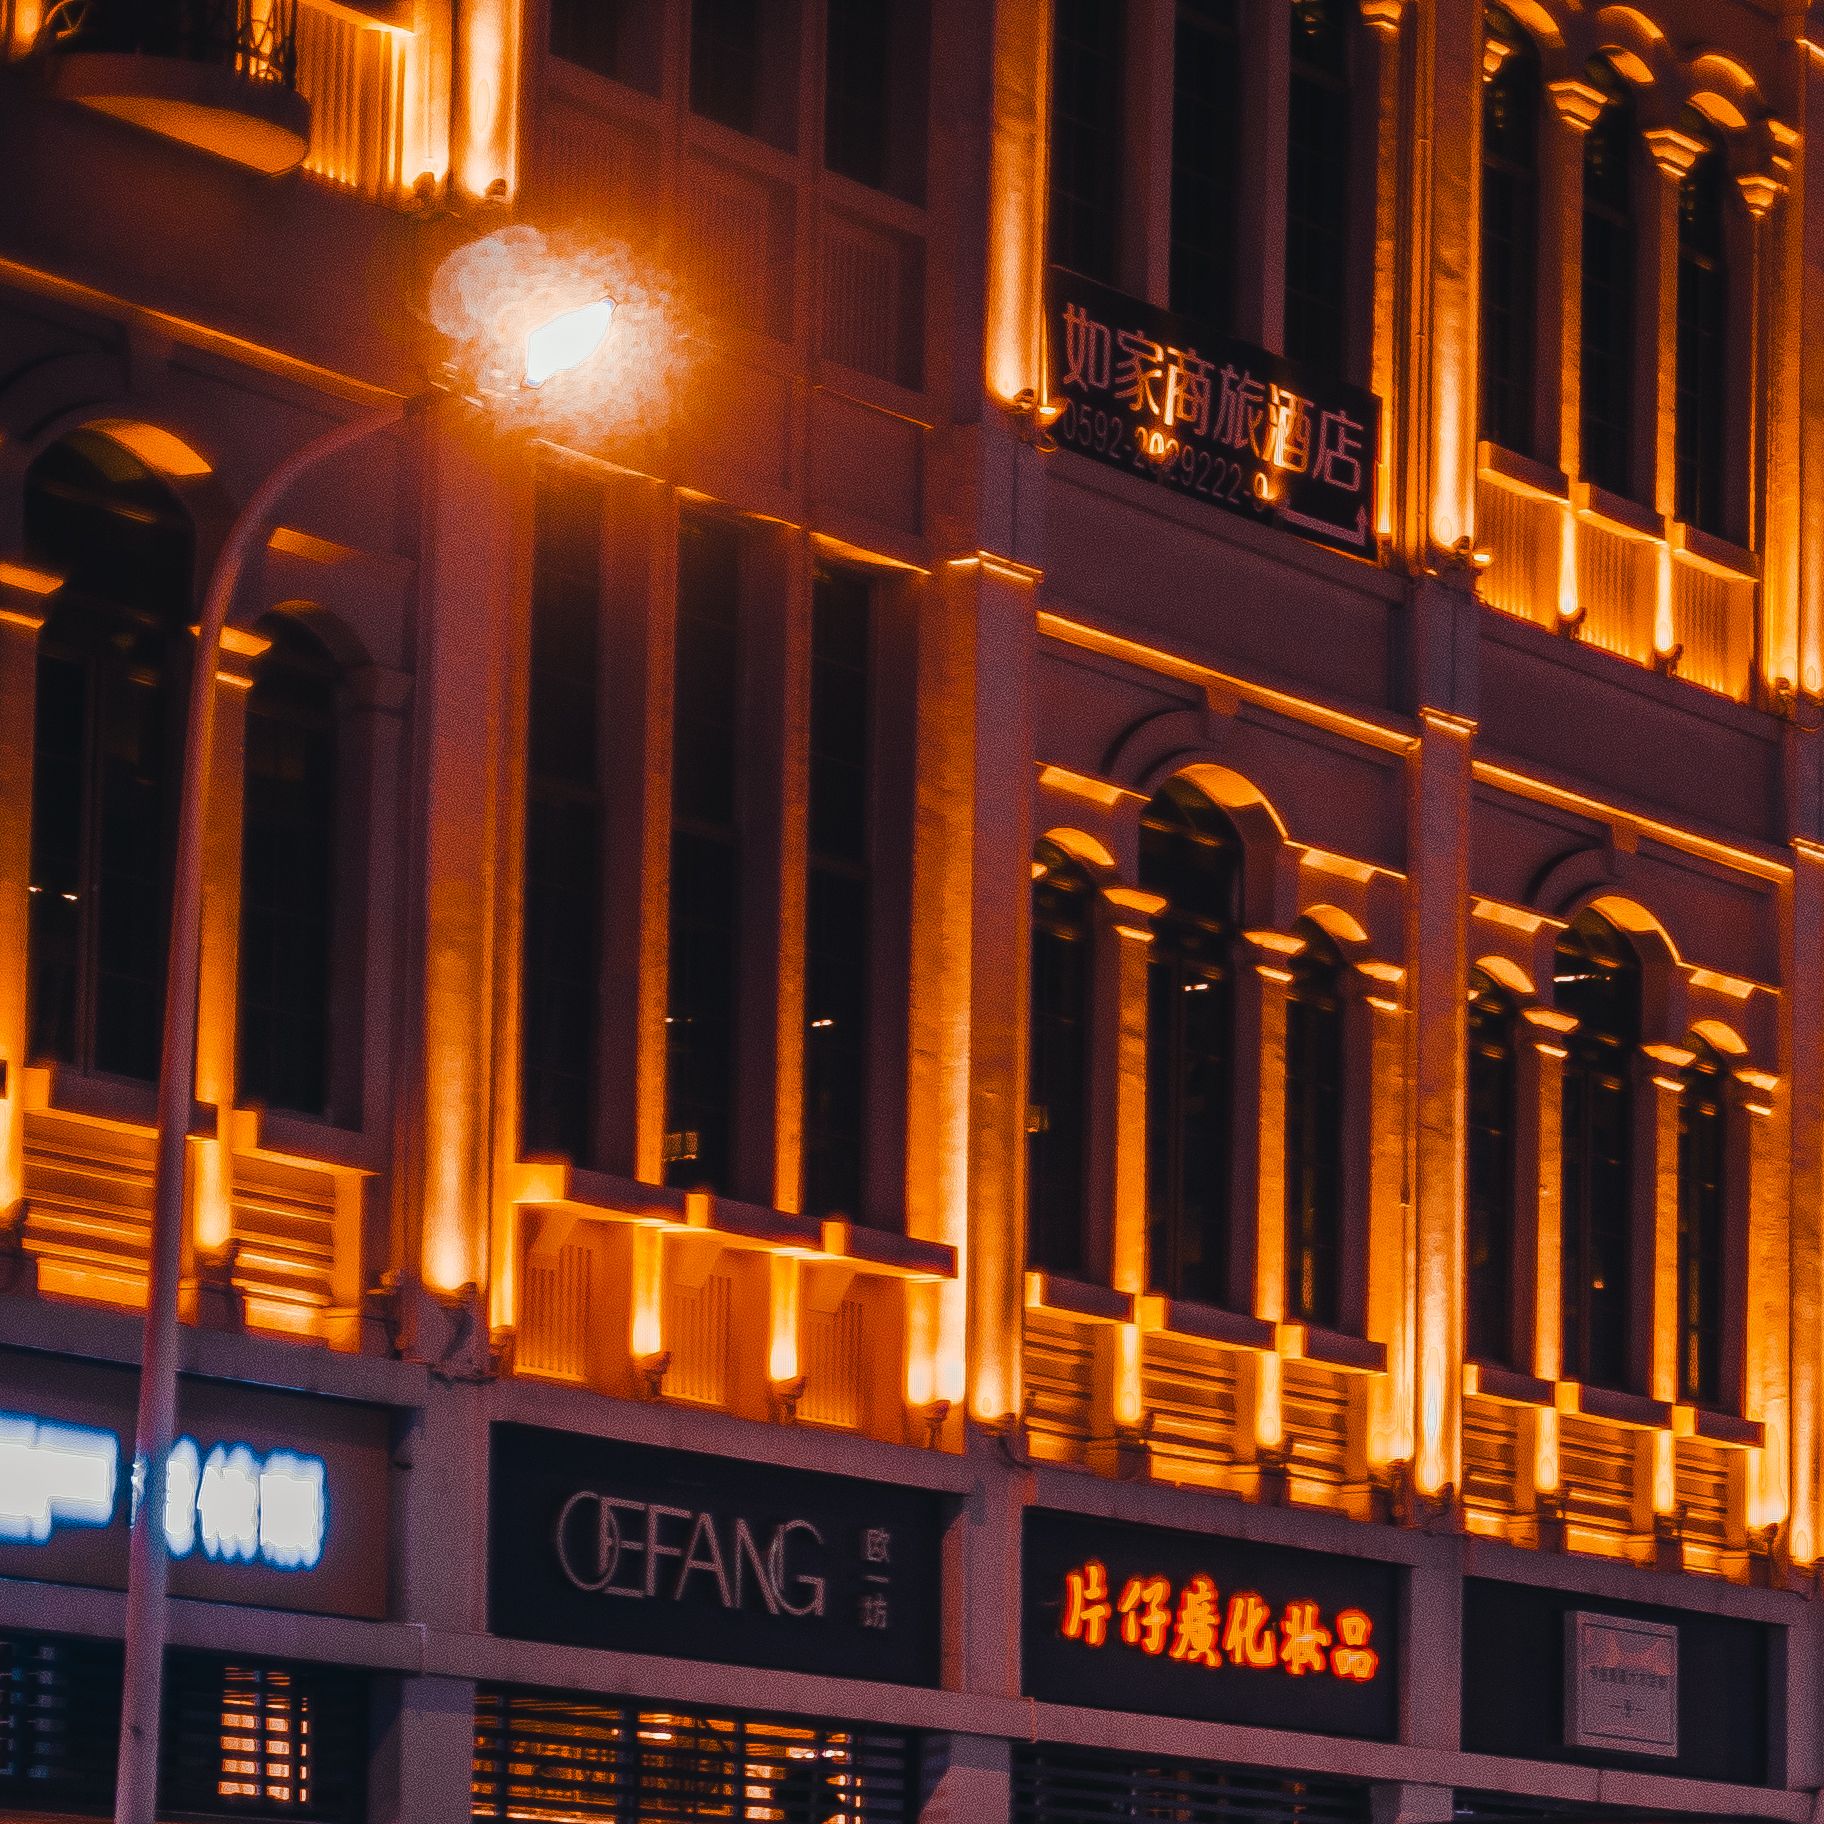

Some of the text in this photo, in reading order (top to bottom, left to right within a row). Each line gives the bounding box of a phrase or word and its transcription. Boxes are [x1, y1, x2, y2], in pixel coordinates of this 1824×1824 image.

[1062, 303, 1366, 493] 如家商旅酒店
